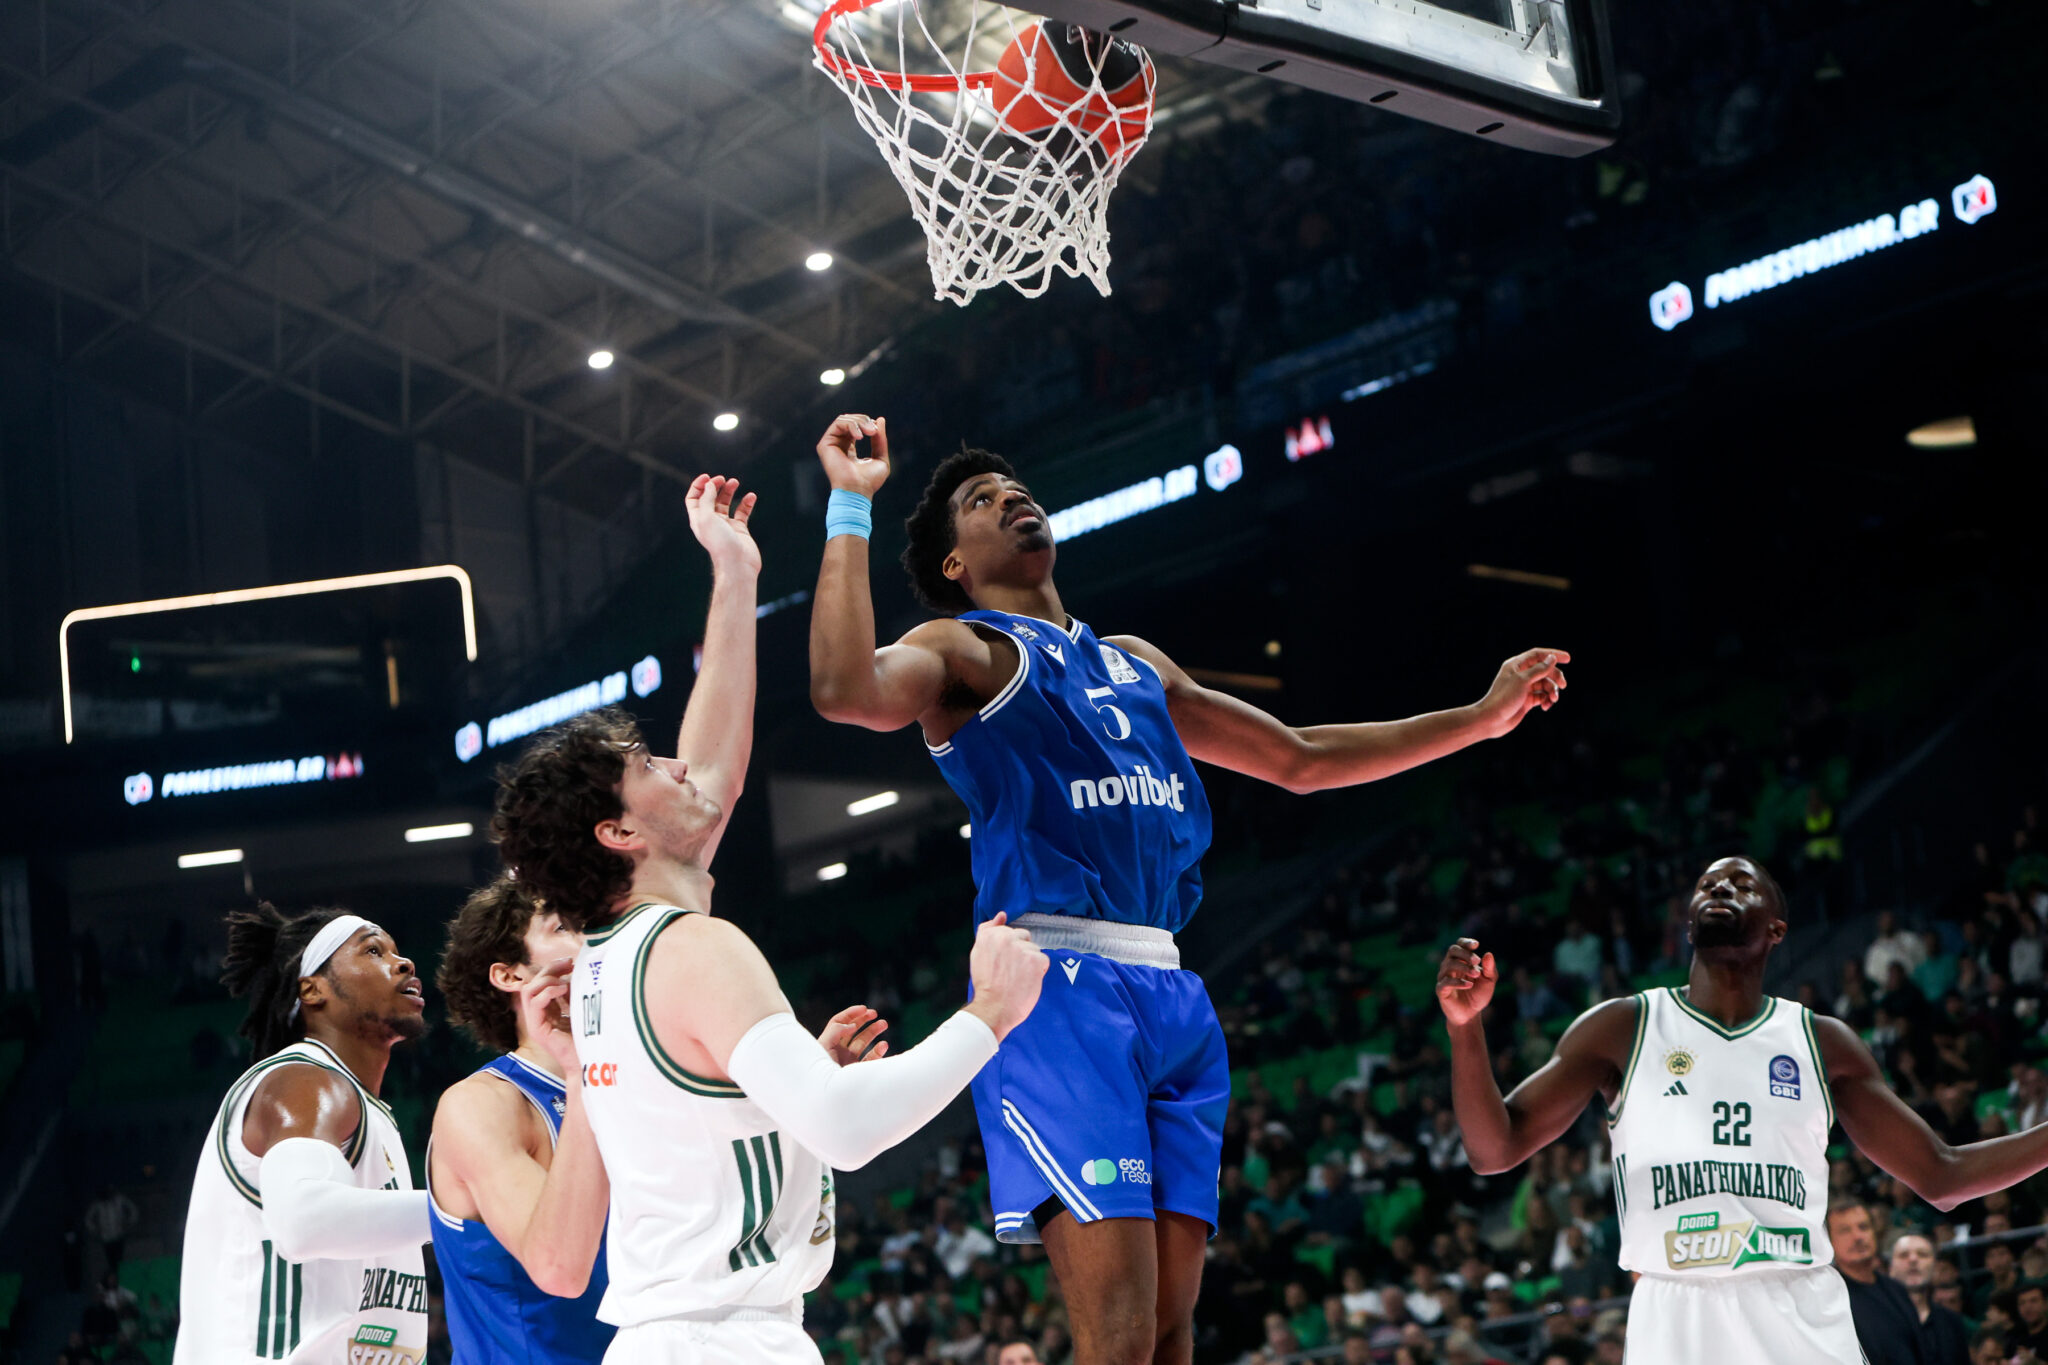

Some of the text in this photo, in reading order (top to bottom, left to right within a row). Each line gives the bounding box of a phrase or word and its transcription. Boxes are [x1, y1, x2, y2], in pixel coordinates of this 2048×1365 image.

[1085, 686, 1132, 740] 5
[1070, 765, 1185, 812] novibet
[1772, 1086, 1799, 1099] GBL
[1713, 1101, 1751, 1146] 22
[1118, 1158, 1145, 1171] eco
[1651, 1160, 1806, 1210] PANATHINAIKOS
[1680, 1214, 1716, 1232] pame
[357, 1326, 393, 1343] pame
